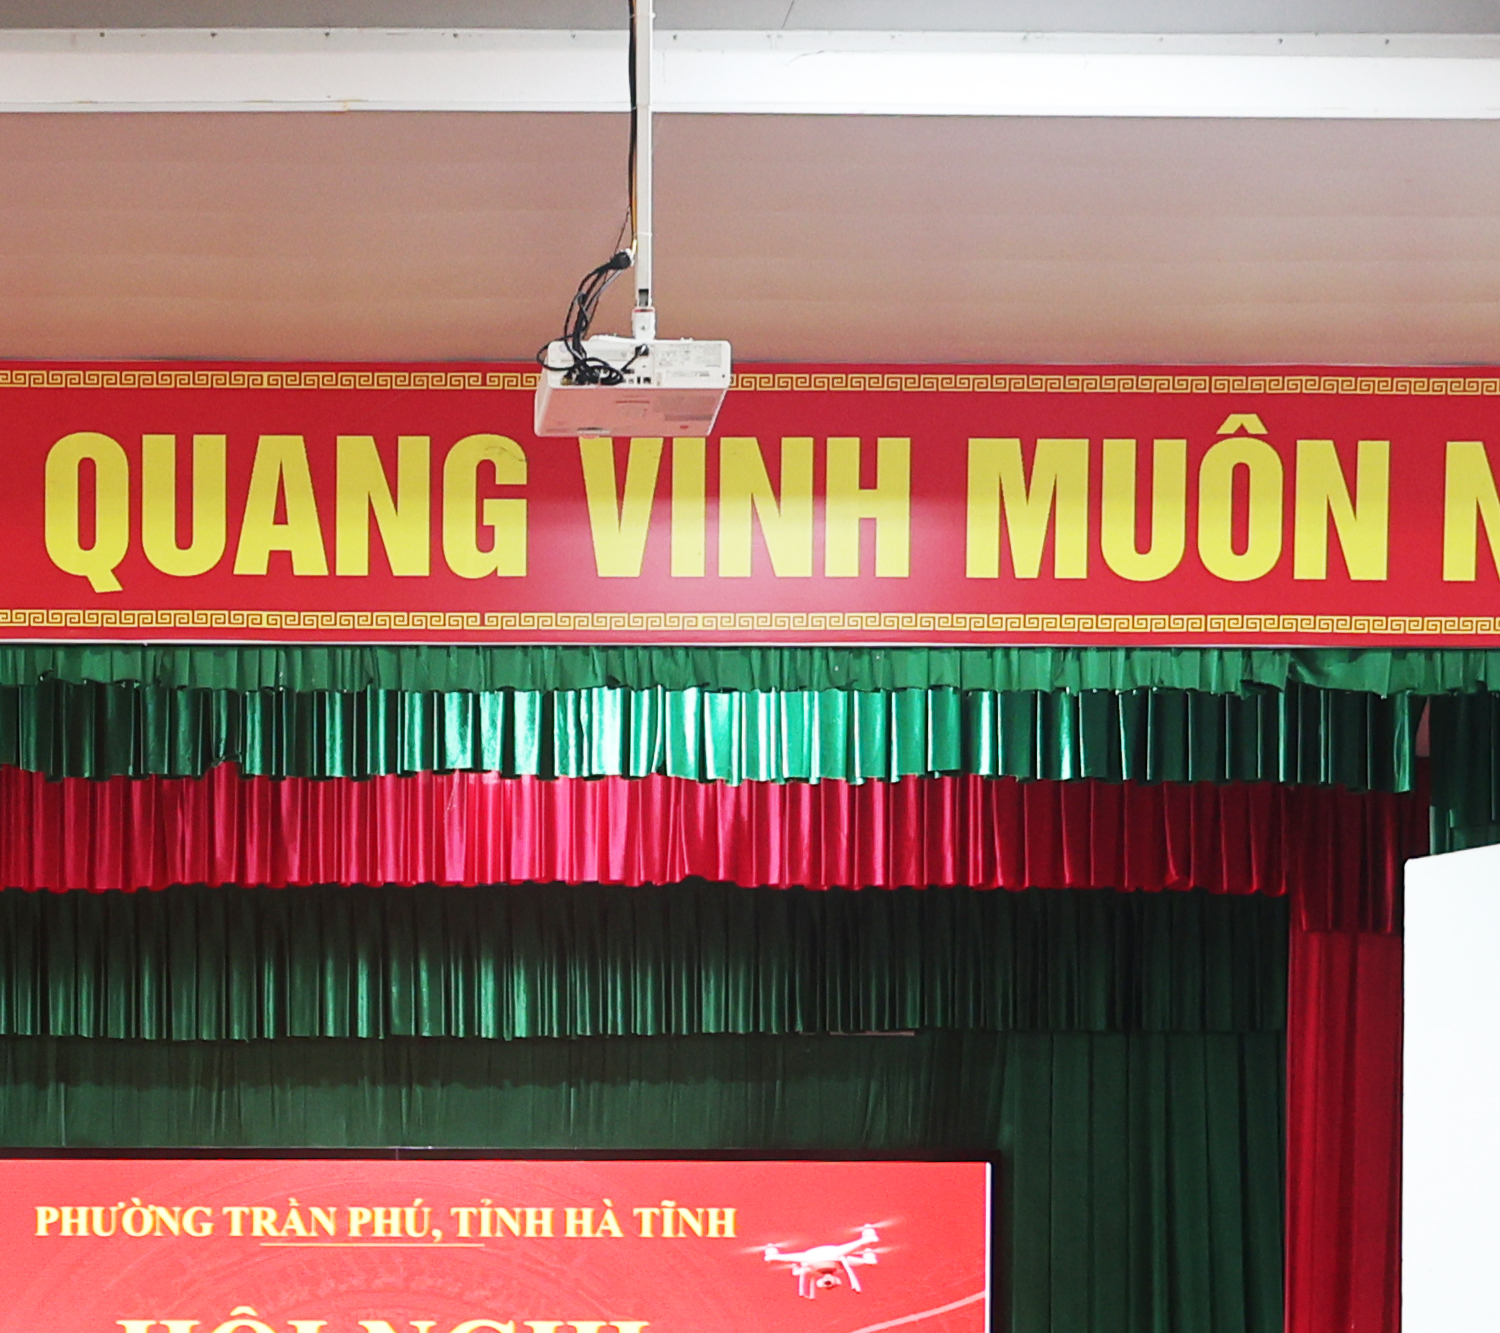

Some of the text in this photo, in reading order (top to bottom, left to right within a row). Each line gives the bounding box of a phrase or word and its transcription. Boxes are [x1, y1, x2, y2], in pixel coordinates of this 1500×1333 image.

[45, 432, 527, 592] QUANG
[579, 437, 911, 577] VINH
[967, 414, 1390, 581] MUÔN
[35, 1198, 737, 1243] PHƯỜNG TRẦN PHÚ, TỈNH HÀ TĨNH
